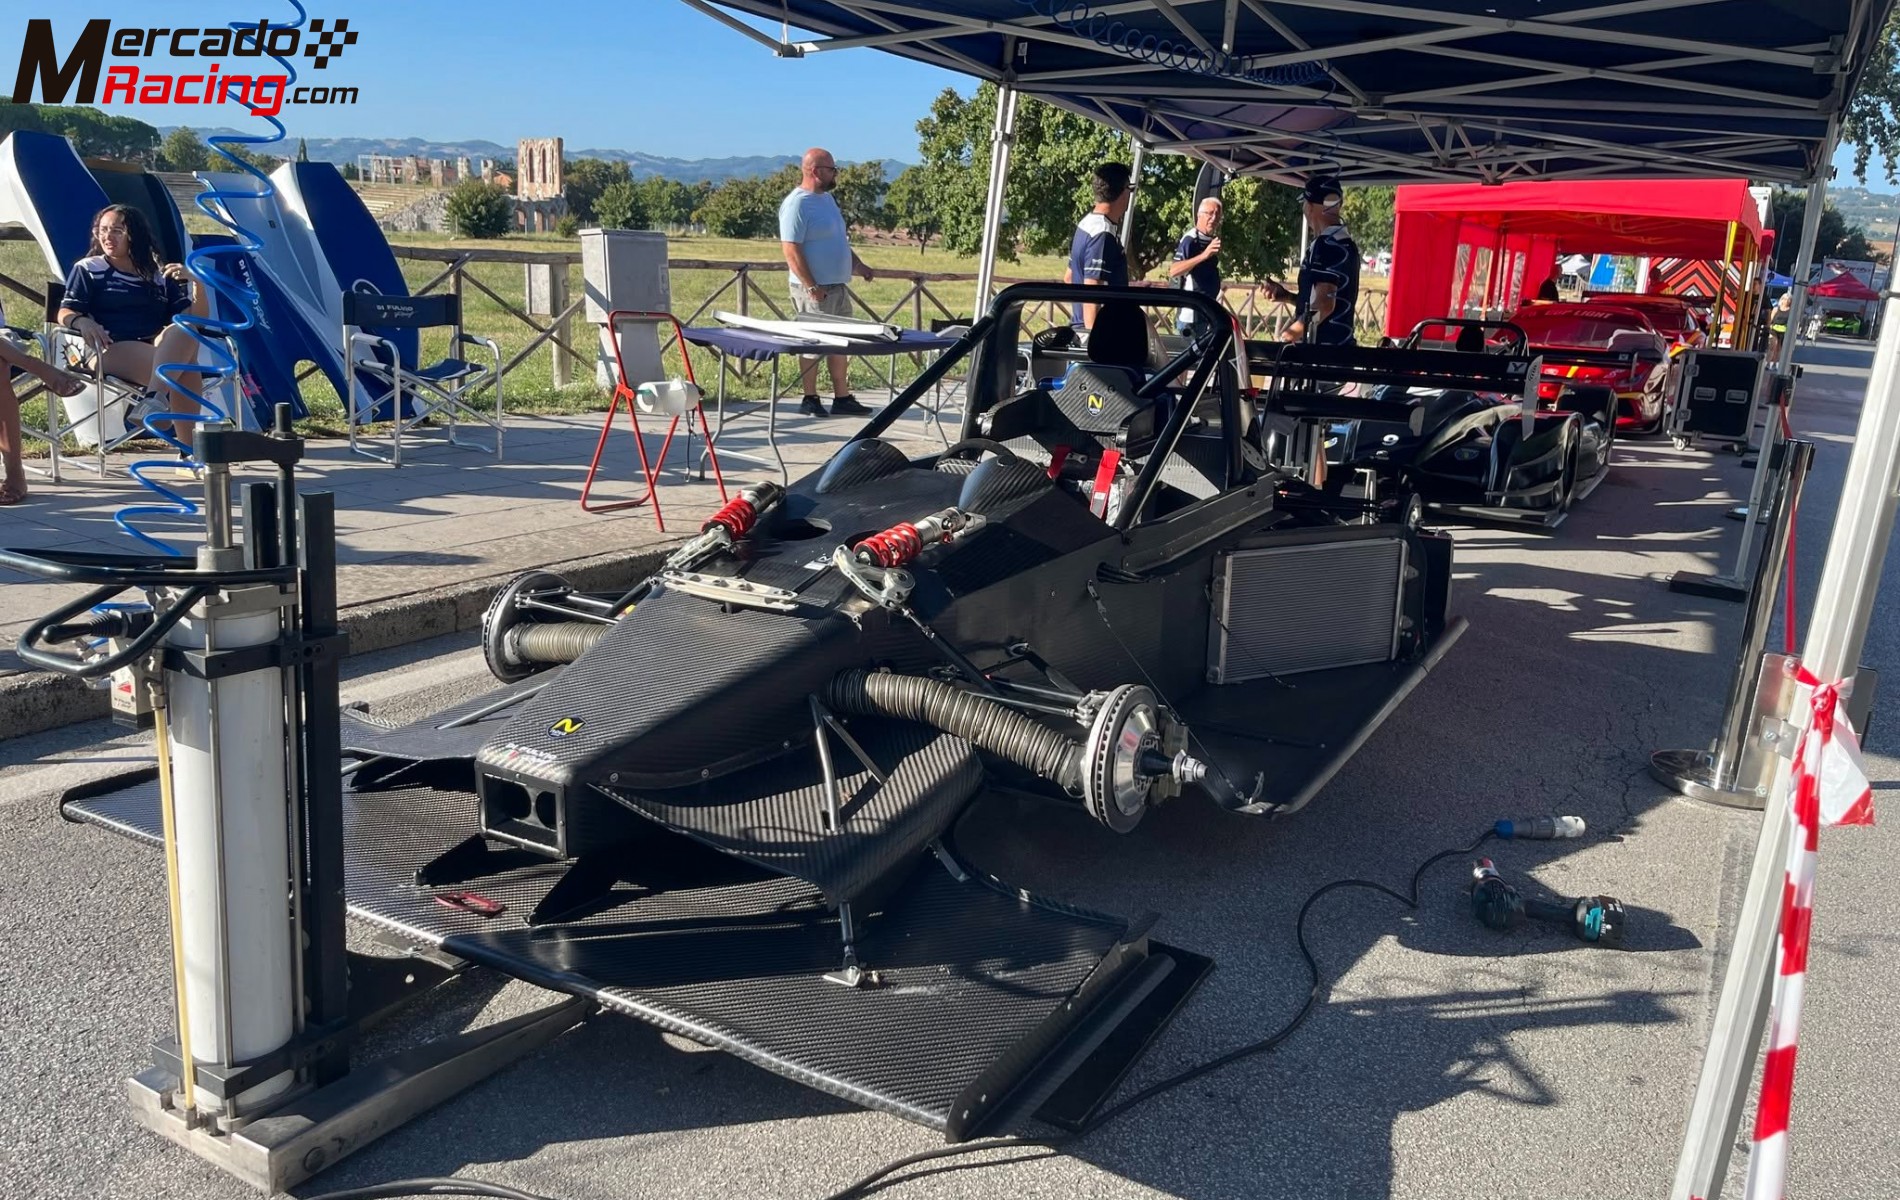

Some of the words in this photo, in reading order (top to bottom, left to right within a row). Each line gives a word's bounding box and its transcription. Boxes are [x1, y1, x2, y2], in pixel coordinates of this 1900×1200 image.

[1573, 310, 1613, 319] LIGHT
[1382, 434, 1399, 446] 9
[519, 745, 557, 760] FULVIO
